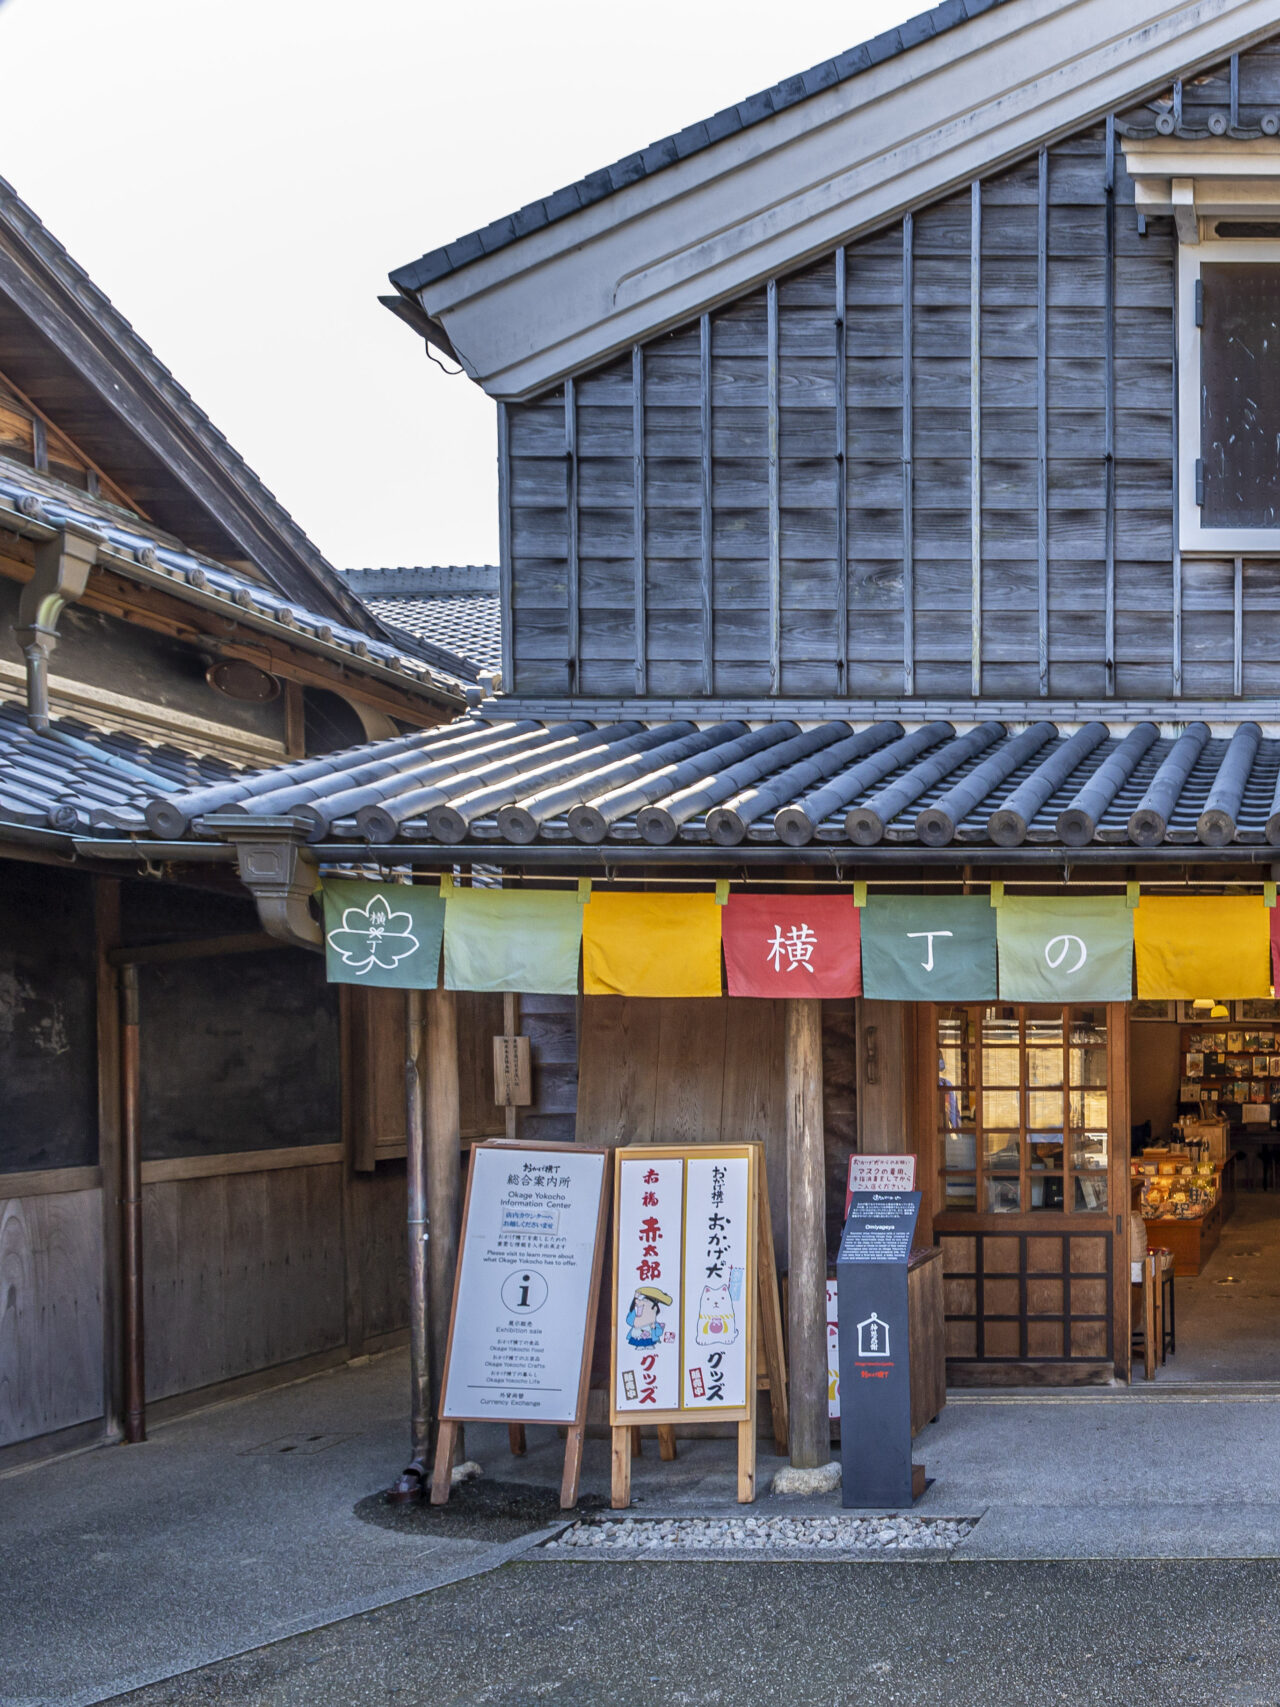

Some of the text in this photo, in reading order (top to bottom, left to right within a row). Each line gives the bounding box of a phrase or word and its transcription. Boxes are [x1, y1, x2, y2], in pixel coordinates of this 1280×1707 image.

[507, 1173, 572, 1188] 総合案内所
[508, 1191, 566, 1201] Okage Yokocho
[711, 1165, 728, 1209] おかげ横丁
[500, 1199, 572, 1209] Information Center
[636, 1216, 663, 1282] 赤太郎
[705, 1212, 731, 1279] おかげ犬
[638, 1353, 659, 1404] グッズ
[706, 1351, 726, 1401] グッズ
[480, 1398, 509, 1406] Currency
